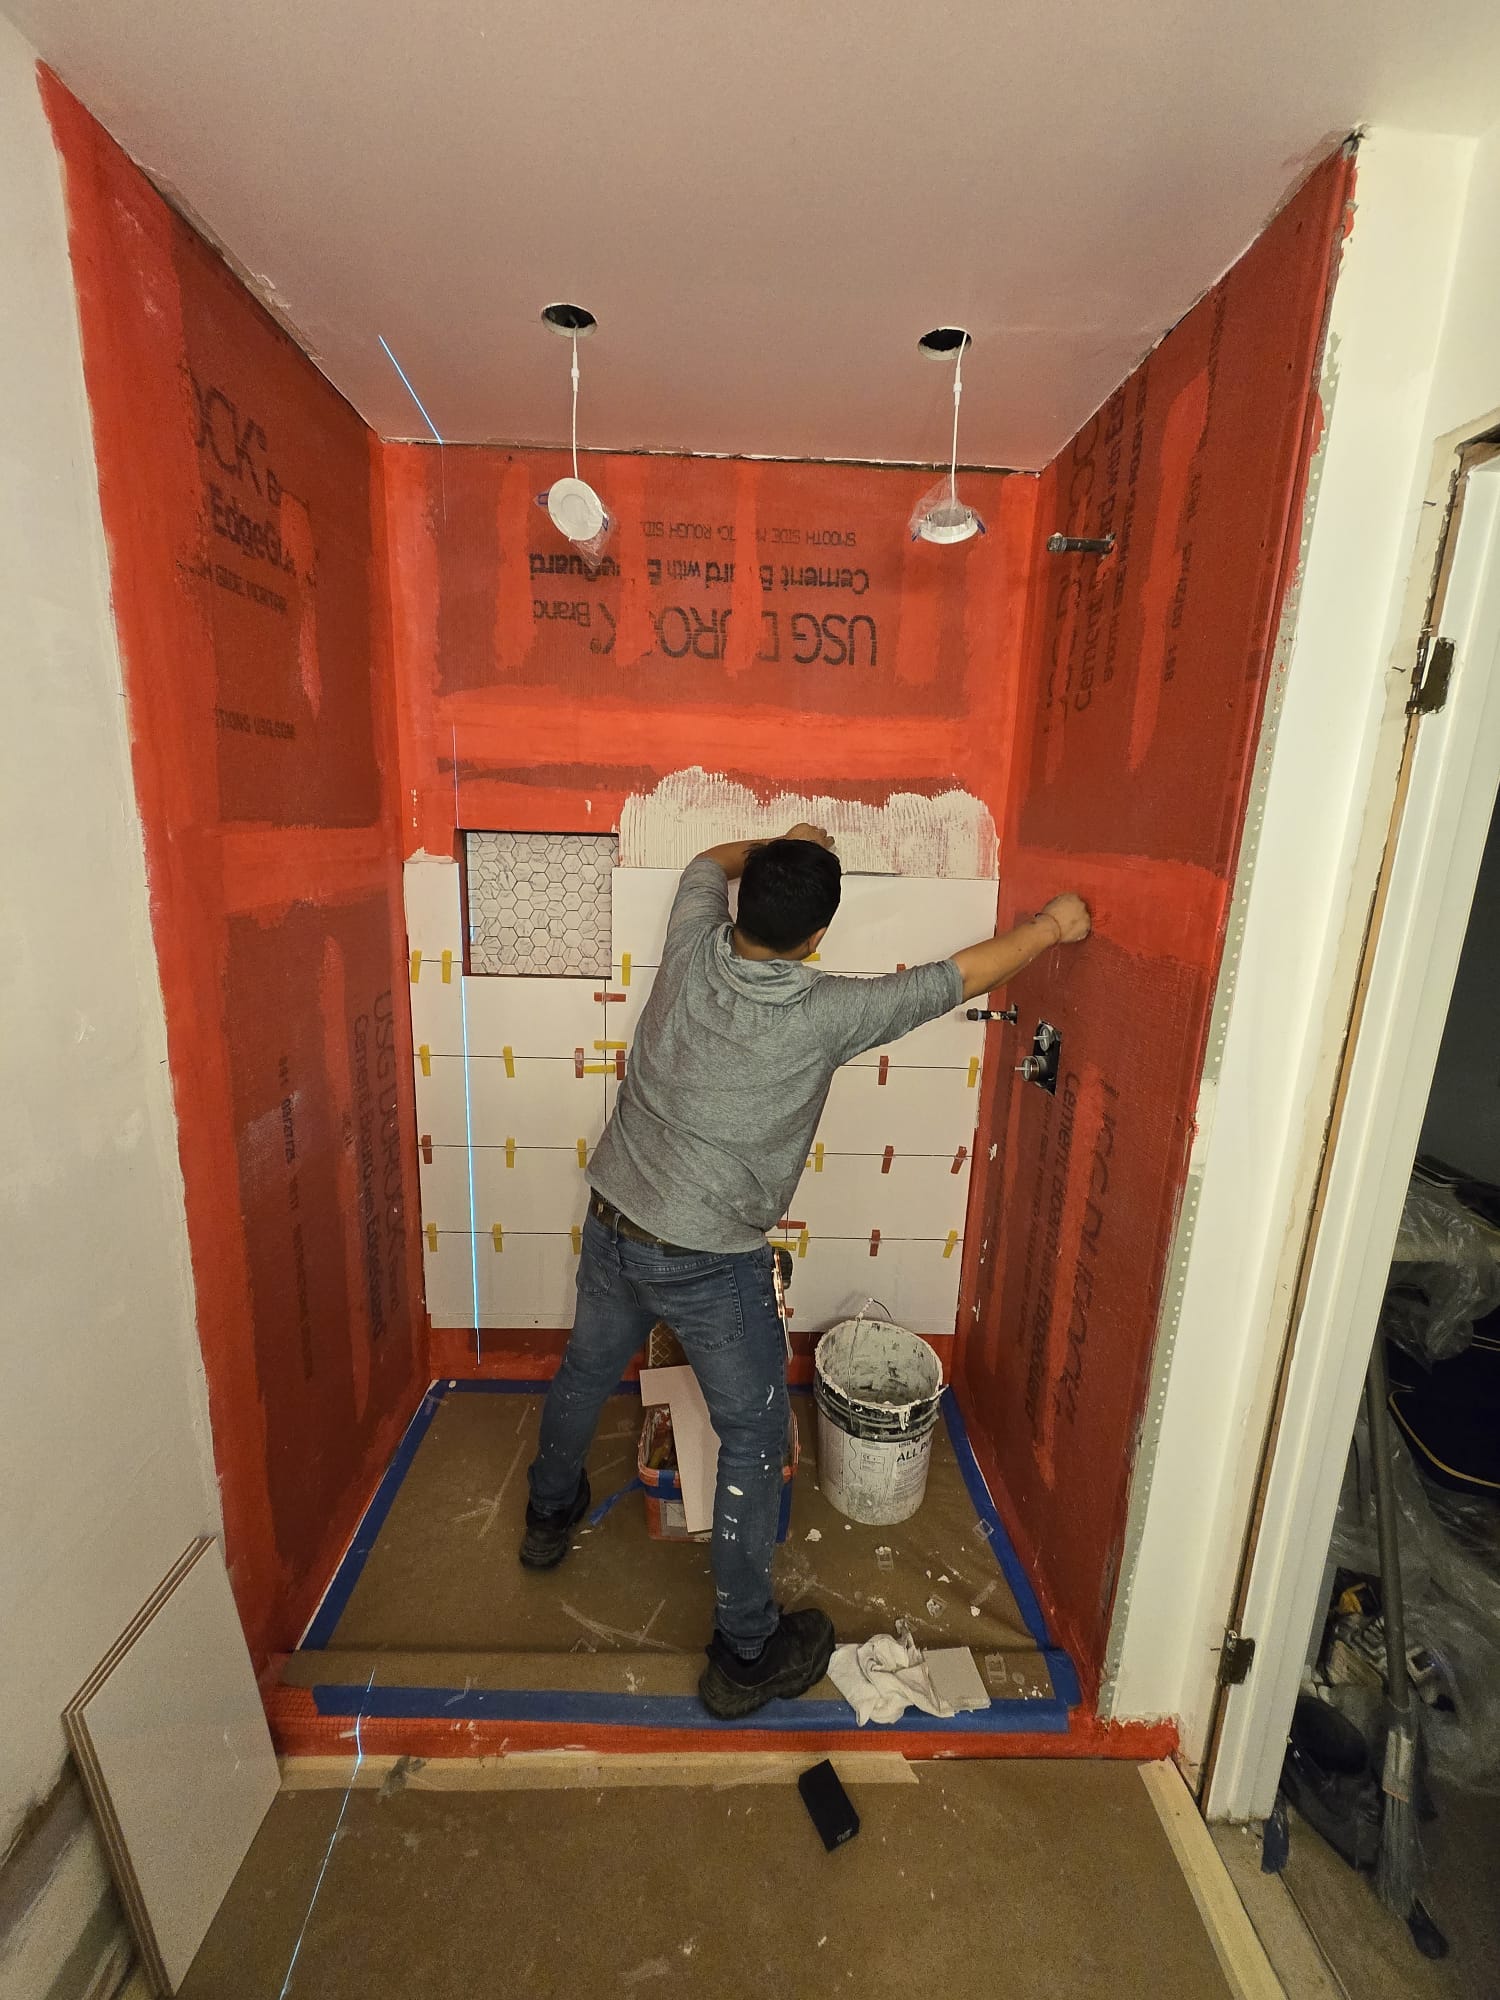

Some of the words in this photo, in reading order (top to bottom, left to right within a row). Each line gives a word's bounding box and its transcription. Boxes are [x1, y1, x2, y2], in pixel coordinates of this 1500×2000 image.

[639, 520, 665, 538] SID
[771, 527, 801, 546] SIDE
[665, 557, 701, 580] with
[704, 560, 774, 594] Bard
[782, 563, 871, 596] Cement
[791, 611, 878, 667] USG
[1052, 1070, 1082, 1175] Cement
[896, 1447, 918, 1463] ALL
